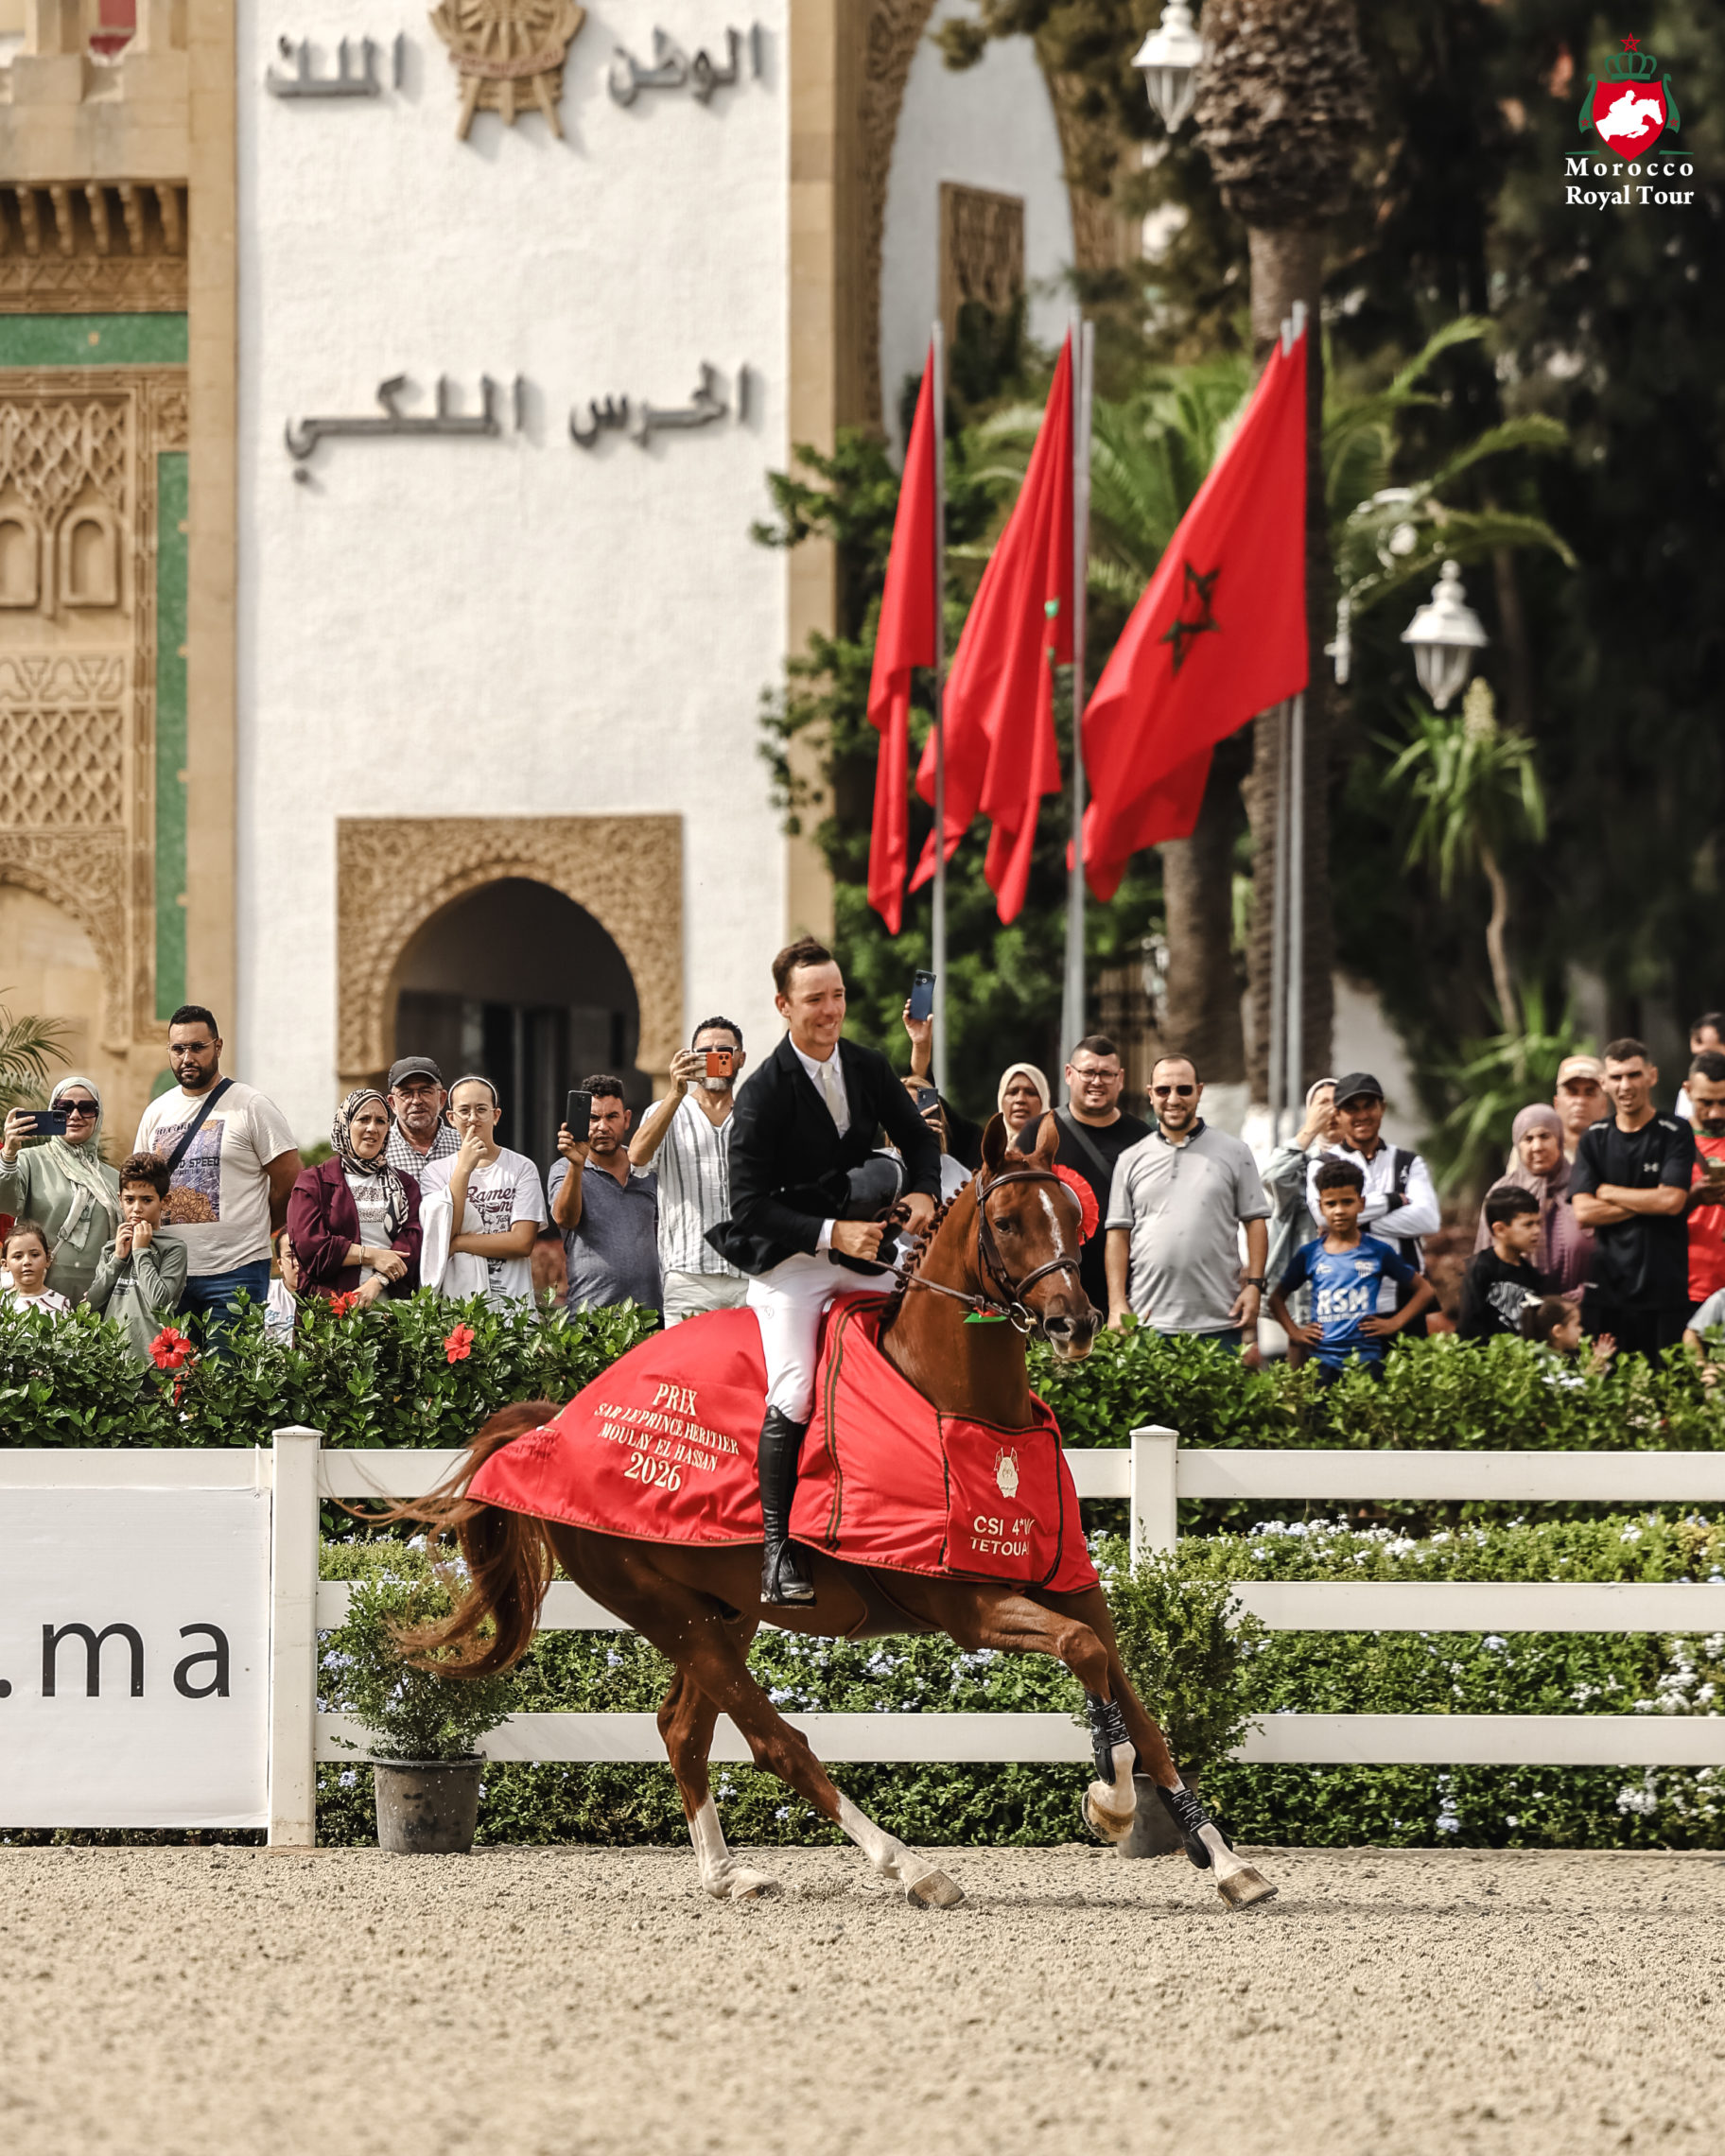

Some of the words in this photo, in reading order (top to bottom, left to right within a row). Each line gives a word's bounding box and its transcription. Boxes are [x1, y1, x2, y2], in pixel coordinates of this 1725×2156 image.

[266, 31, 405, 98] الملك
[608, 22, 764, 107] الوطن
[570, 358, 751, 447] الحرس
[286, 373, 526, 484] الملكي
[1316, 1286, 1369, 1314] RSM
[653, 1382, 698, 1417] PRIX
[594, 1402, 623, 1419] SAR
[685, 1422, 740, 1455] HERITIER
[598, 1422, 653, 1452] MOULAY
[654, 1438, 671, 1457] EL
[673, 1444, 719, 1472] HASSAN
[624, 1452, 682, 1492] 2026
[974, 1515, 1004, 1537] CSI
